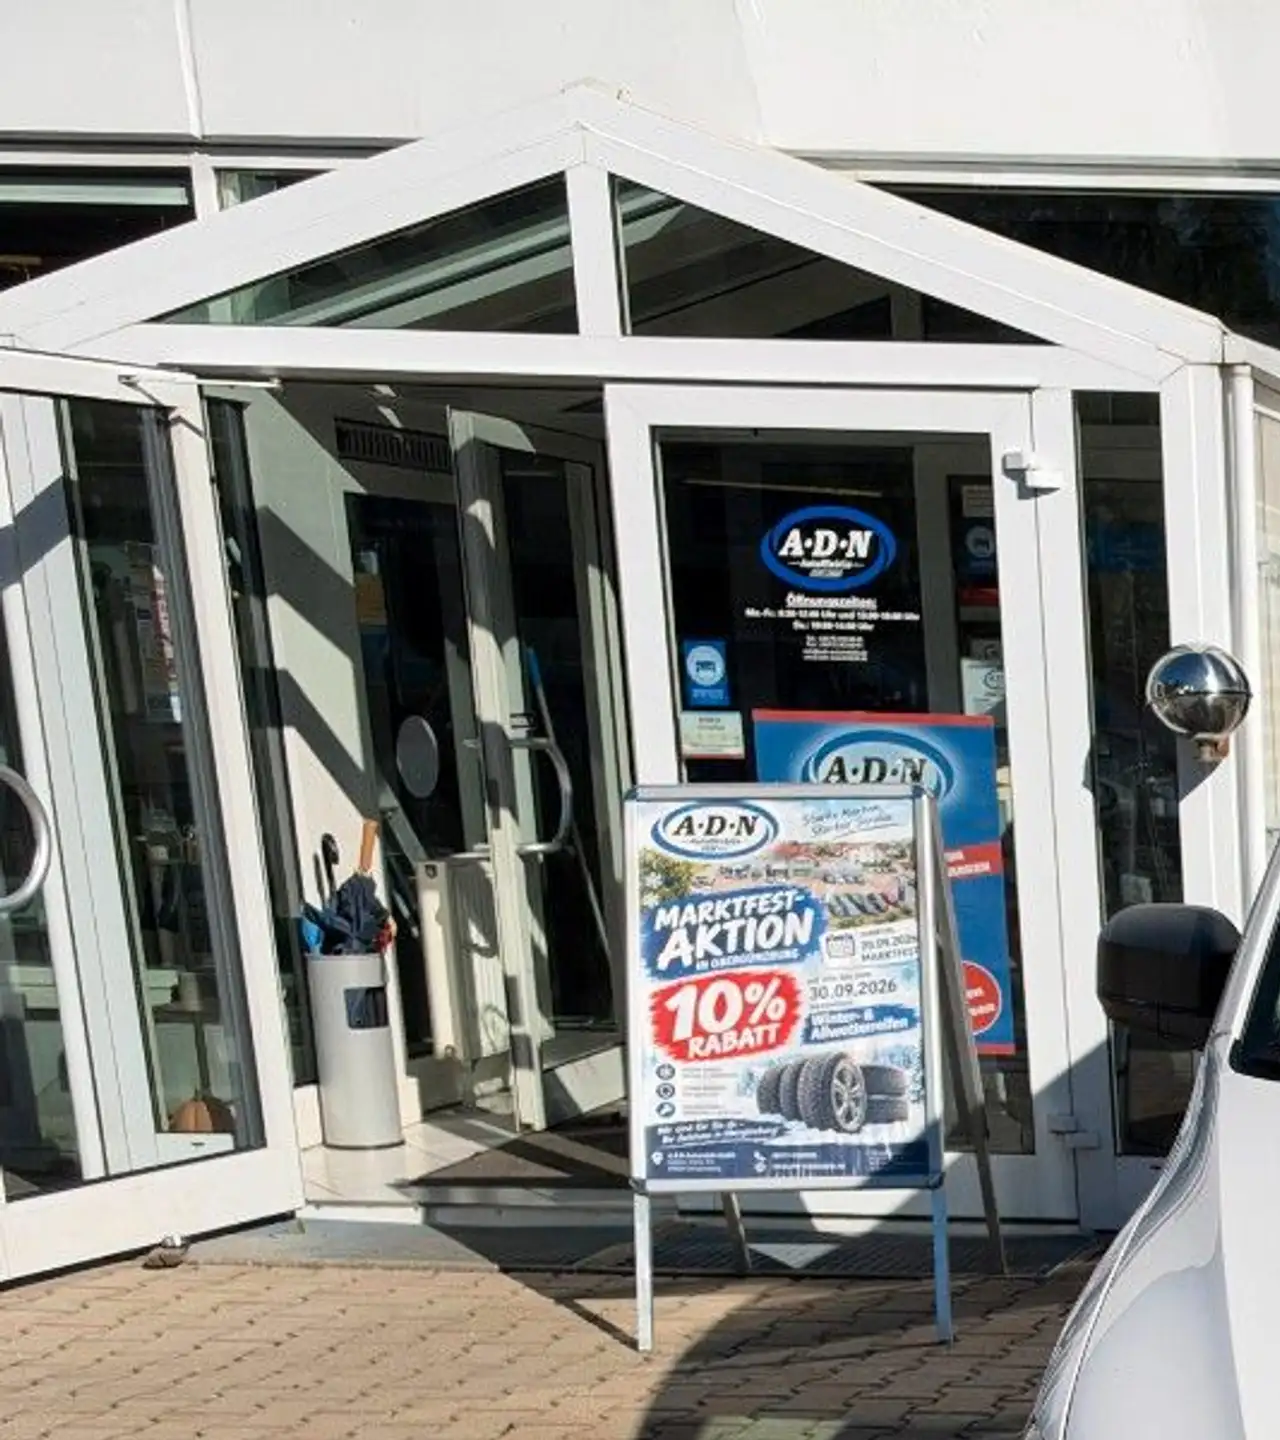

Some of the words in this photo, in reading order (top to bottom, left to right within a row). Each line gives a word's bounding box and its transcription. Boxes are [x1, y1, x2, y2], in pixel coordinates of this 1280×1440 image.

[655, 890, 806, 931] MARKTFEST-
[657, 908, 815, 970] AKTION
[665, 977, 787, 1041] 10%
[809, 979, 897, 1001] 30.09.2026
[687, 1025, 781, 1059] RABATT
